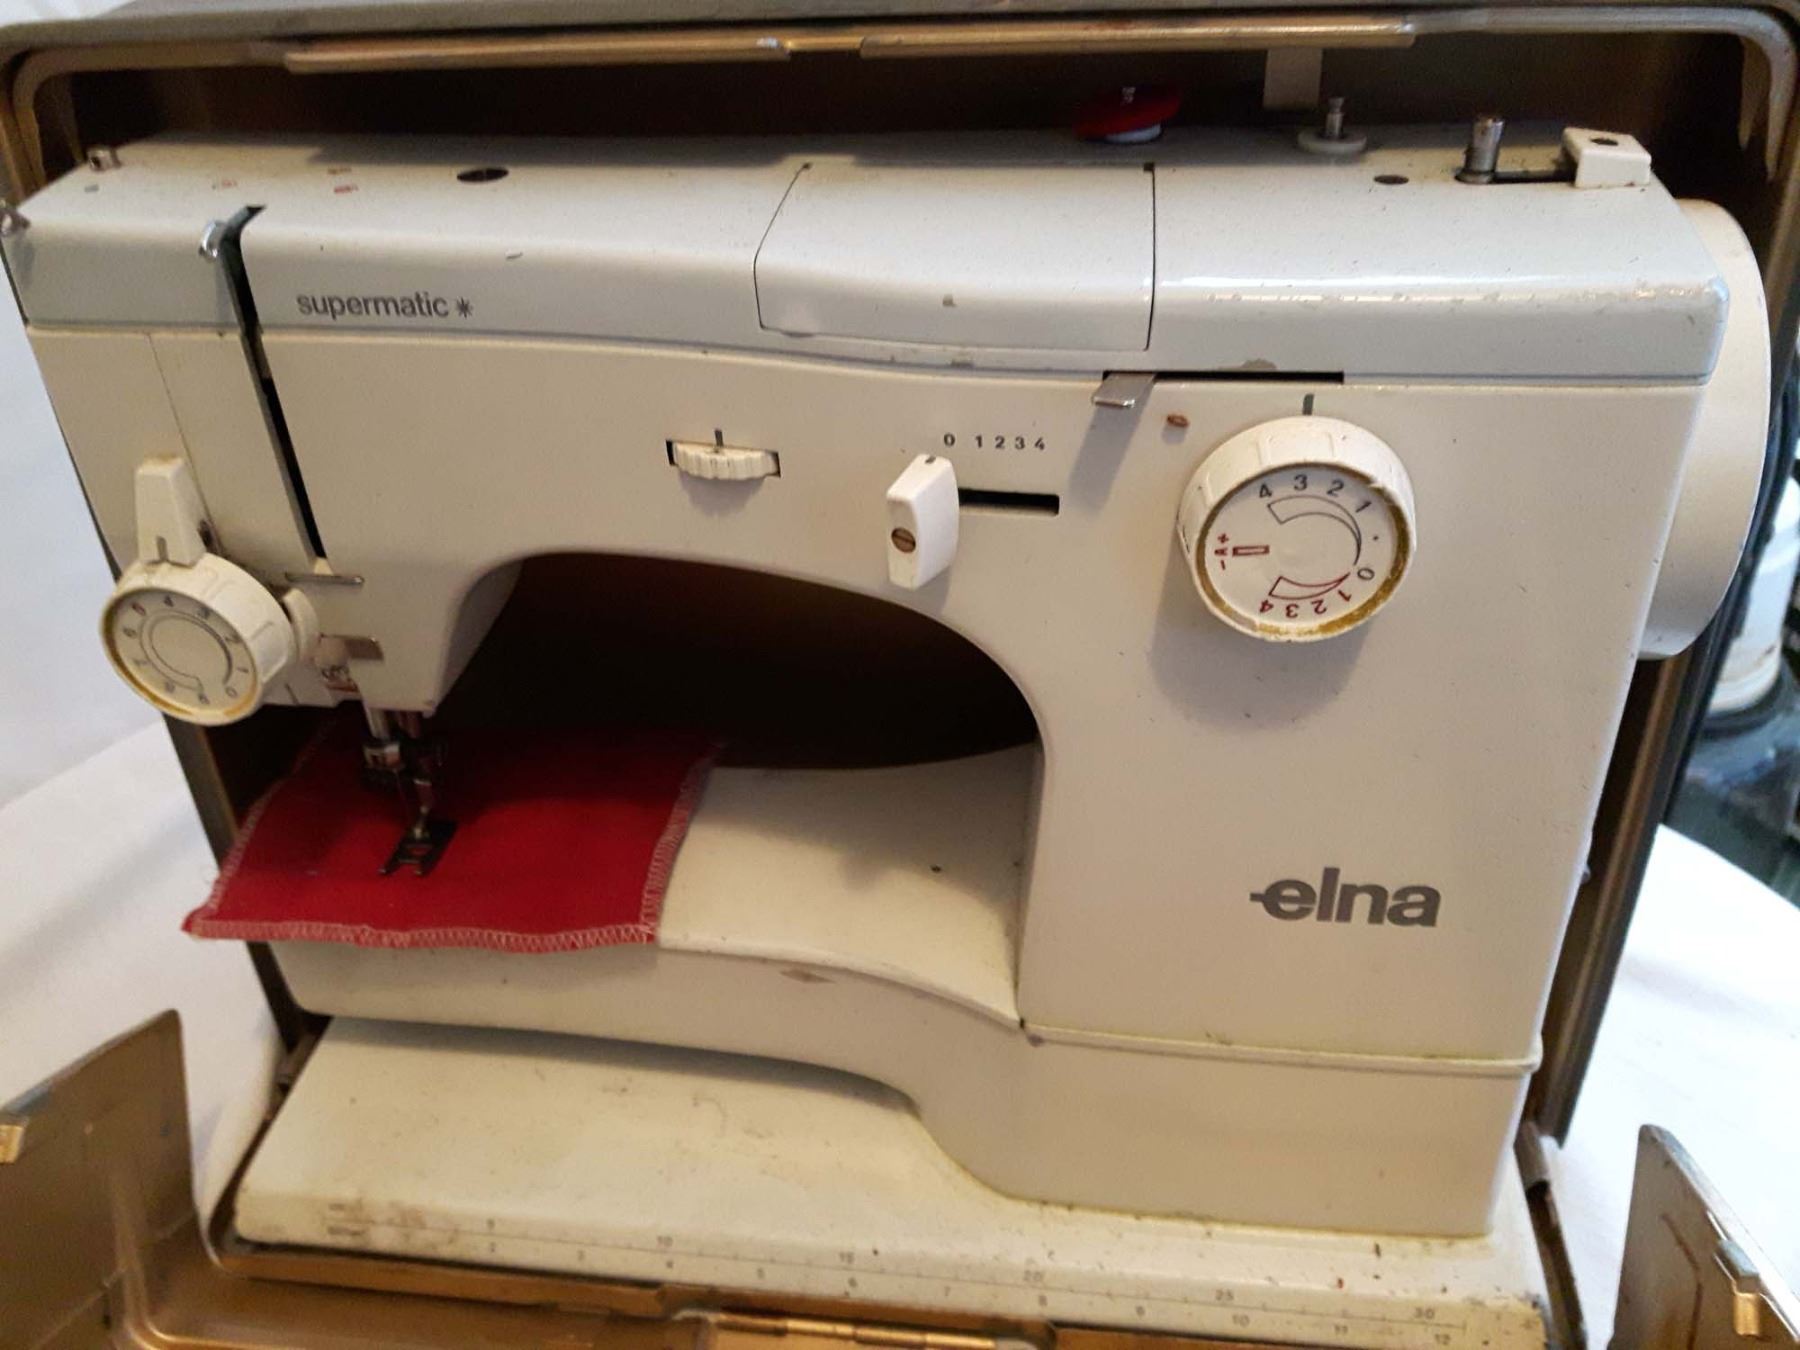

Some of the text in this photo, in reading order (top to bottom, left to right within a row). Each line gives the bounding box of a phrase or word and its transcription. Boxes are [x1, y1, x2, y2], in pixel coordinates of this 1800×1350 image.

[297, 291, 449, 321] supermatic
[943, 433, 1046, 451] 0 1 2 3 4
[1259, 484, 1273, 497] 4
[1294, 475, 1308, 491] 3
[1327, 480, 1345, 496] 2
[1356, 502, 1372, 513] 1
[1258, 599, 1275, 614] 4
[1285, 602, 1300, 618] 3
[1250, 867, 1441, 927] elna
